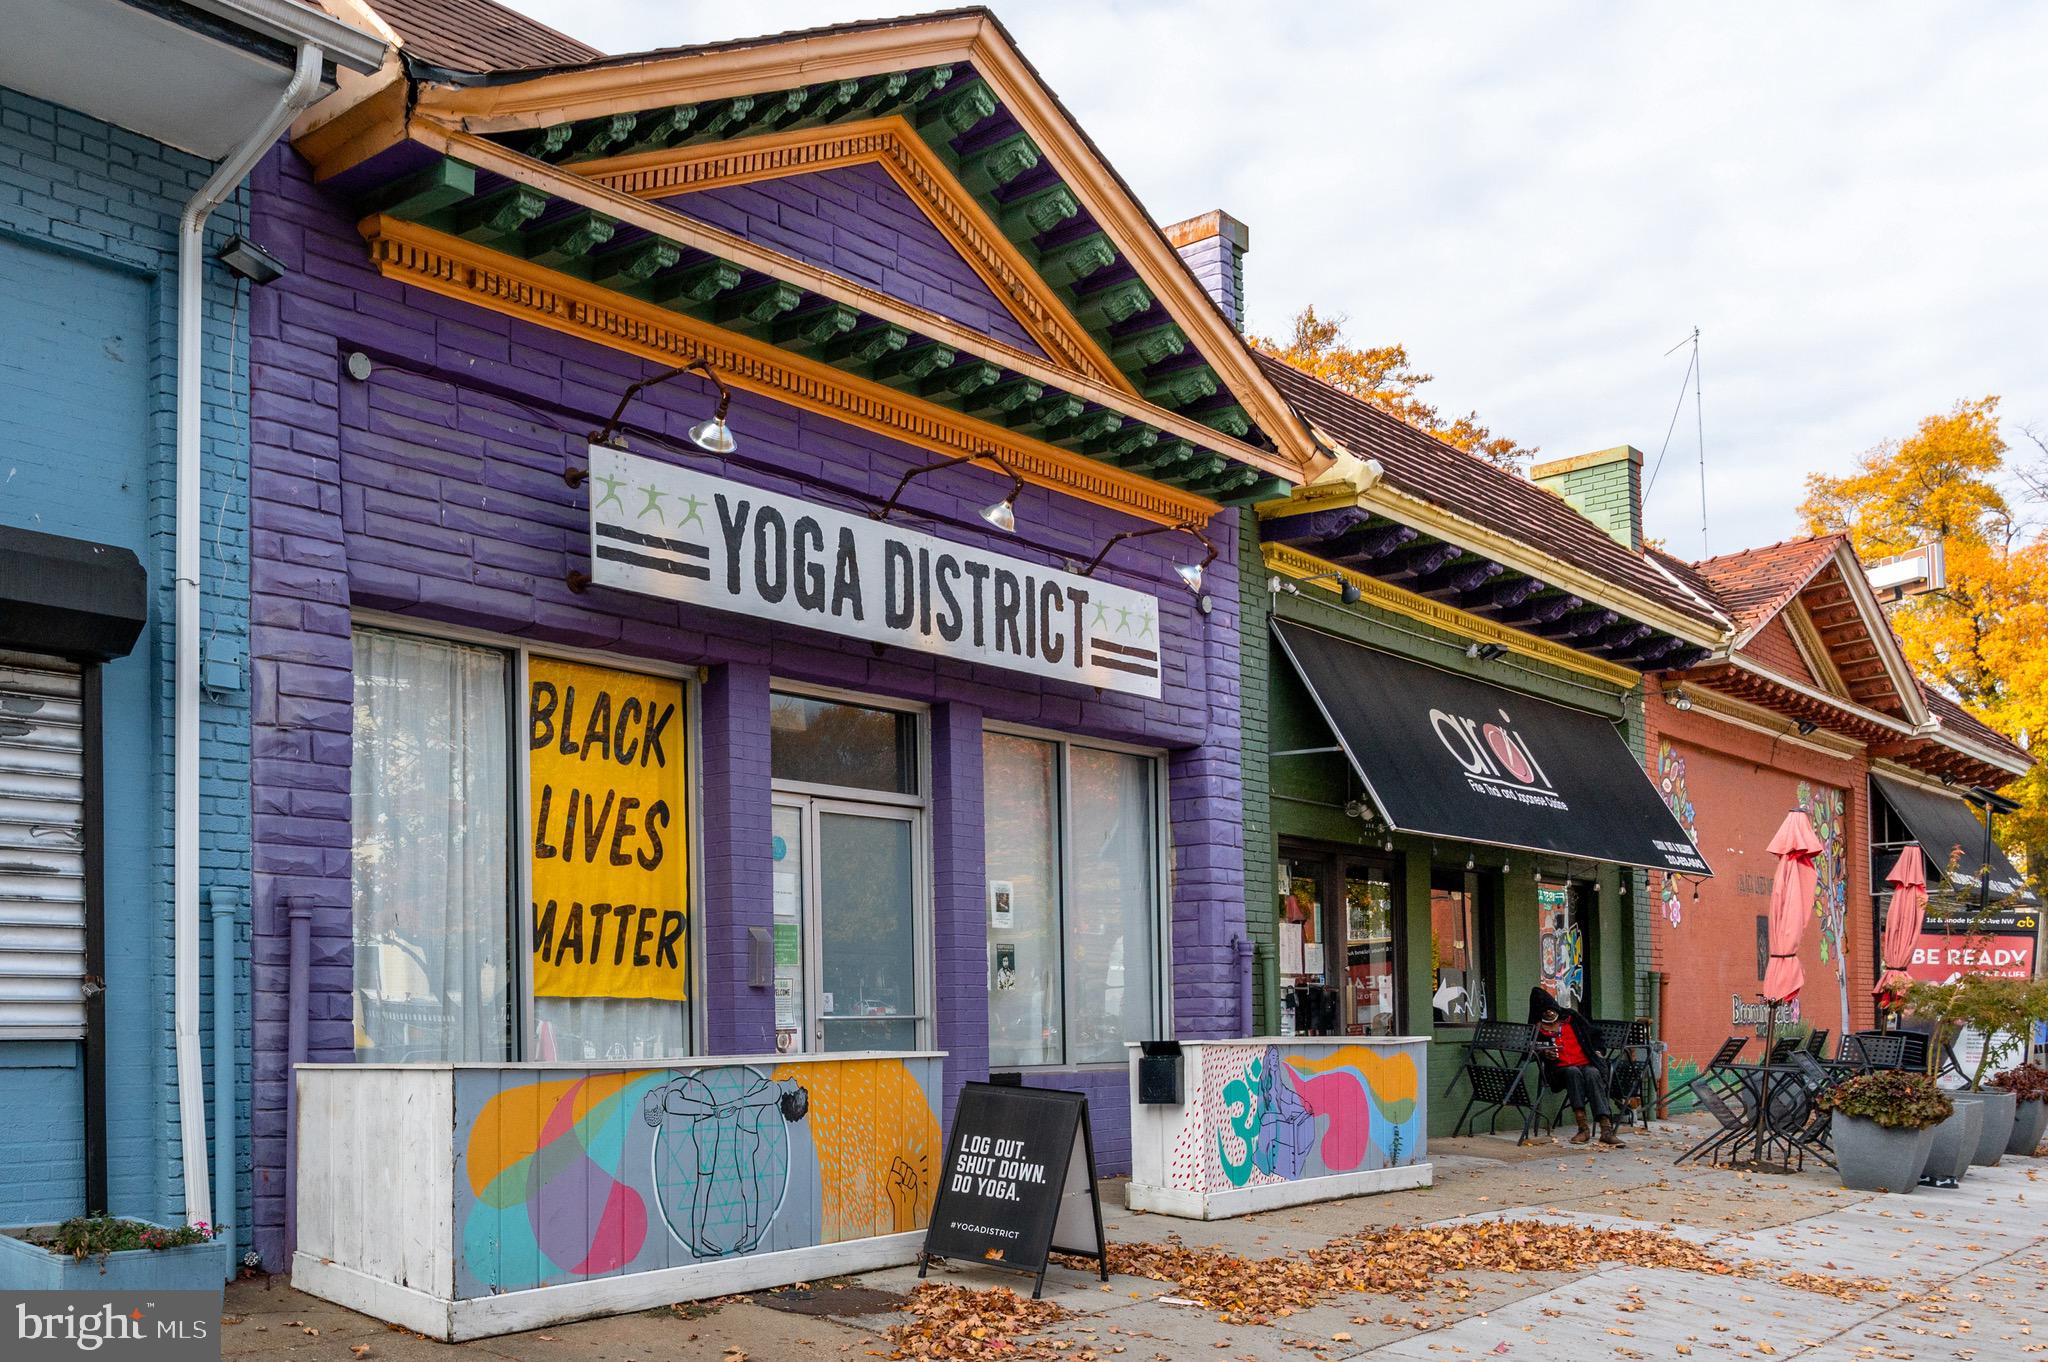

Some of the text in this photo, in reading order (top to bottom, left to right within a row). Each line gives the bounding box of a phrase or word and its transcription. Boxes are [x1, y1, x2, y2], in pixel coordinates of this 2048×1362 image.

[713, 493, 1089, 669] YOGA DISTRICT
[530, 681, 674, 768] BLACK
[1501, 788, 1517, 800] and
[535, 784, 670, 871] LIVES
[532, 900, 687, 969] MATTER
[1911, 948, 2027, 966] BE READY
[961, 1134, 1026, 1160] LOG OUT.
[956, 1154, 1046, 1184] SHUT DOWN.
[951, 1174, 1020, 1201] DO YOGA.
[950, 1222, 1020, 1239] #YOGADISTRICT
